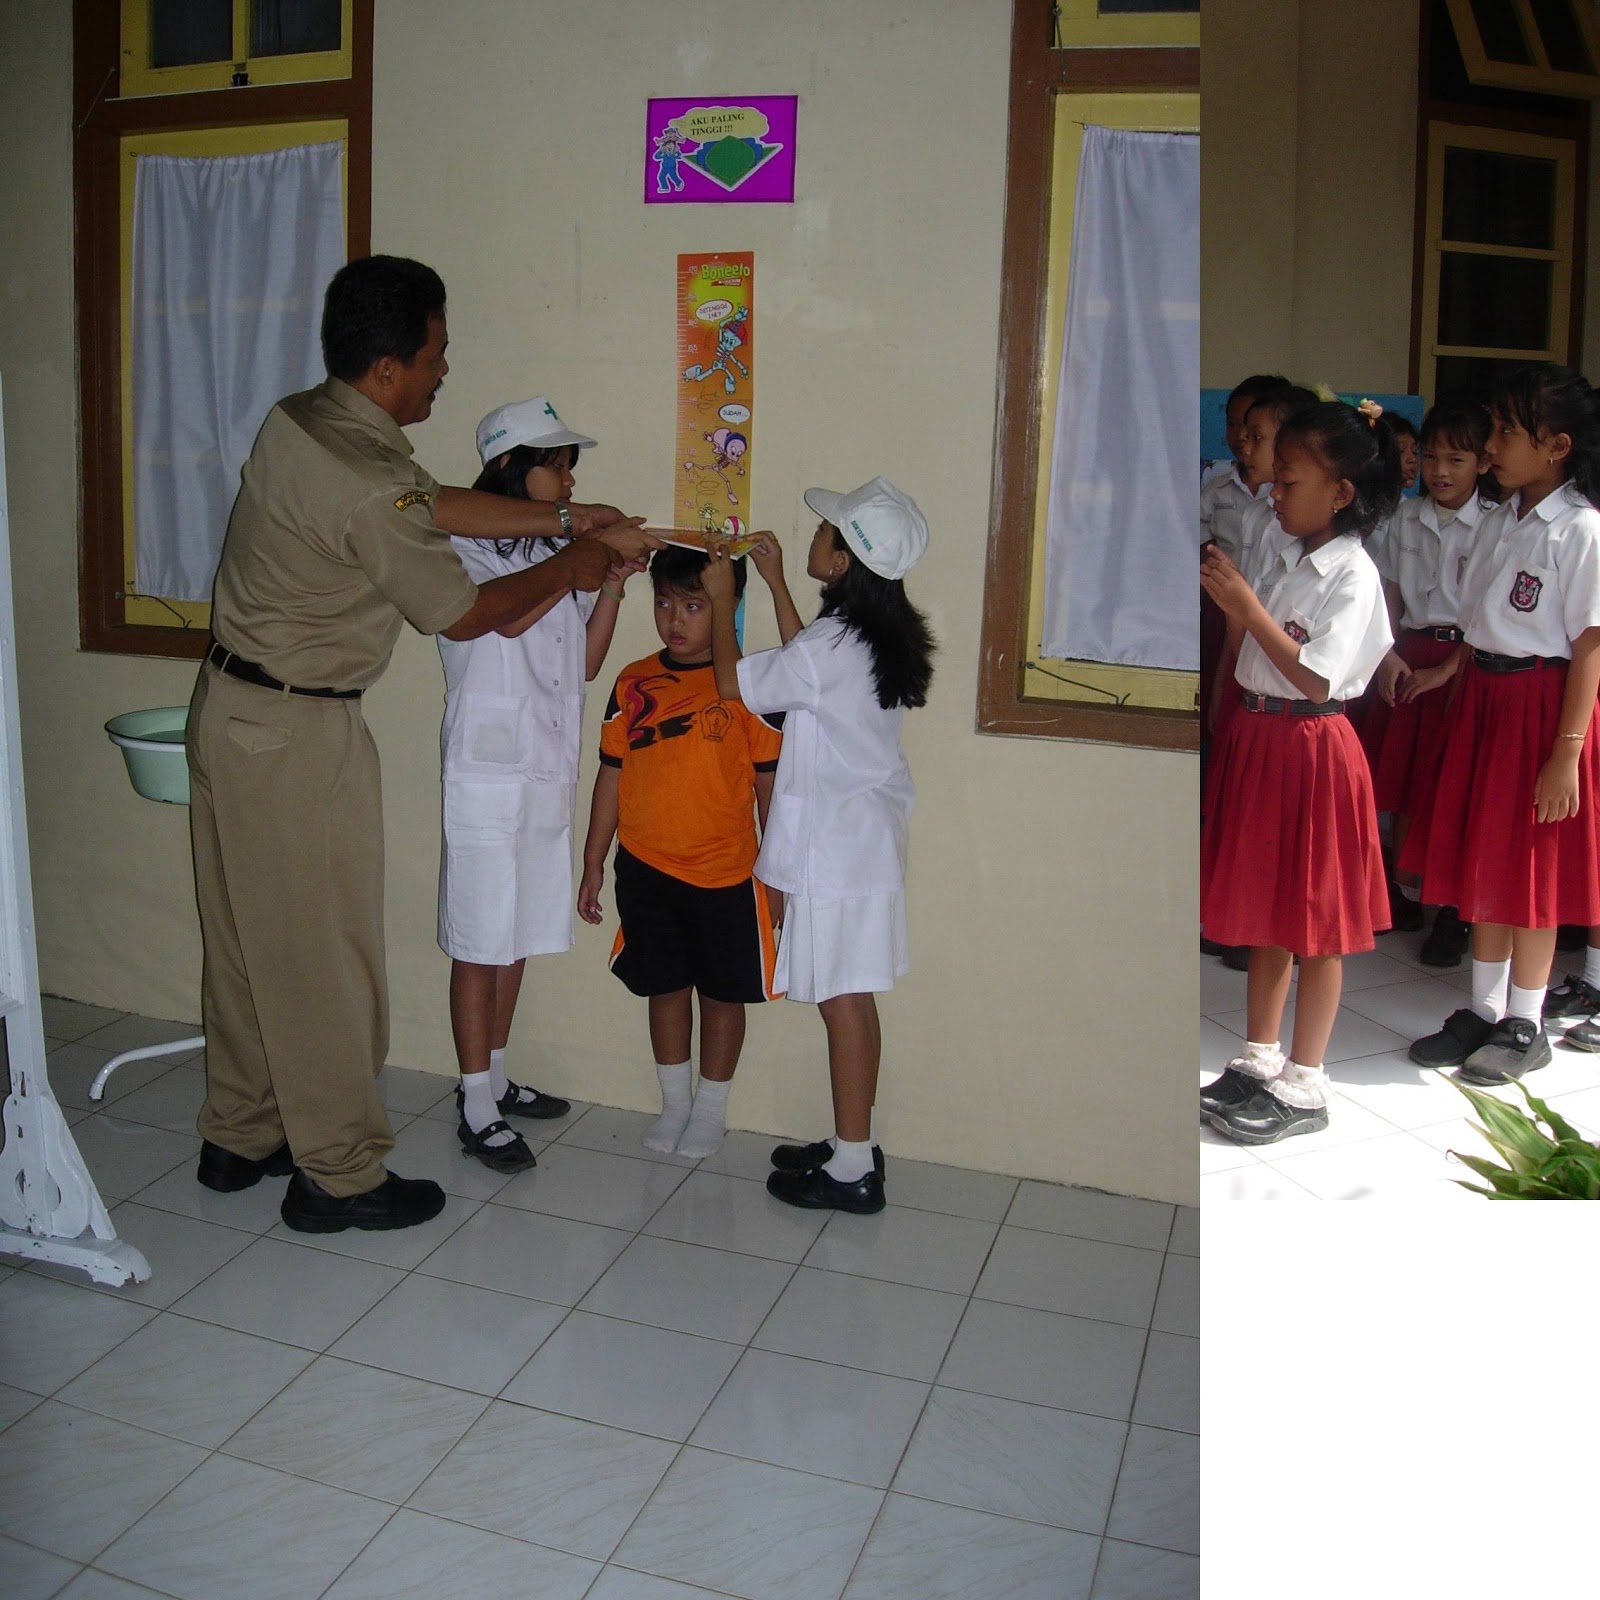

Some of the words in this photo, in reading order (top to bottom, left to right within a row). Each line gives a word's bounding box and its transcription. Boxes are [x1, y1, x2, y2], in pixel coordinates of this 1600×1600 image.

[690, 116, 710, 126] AKU
[711, 113, 745, 123] PALING
[691, 126, 722, 136] TINGGI
